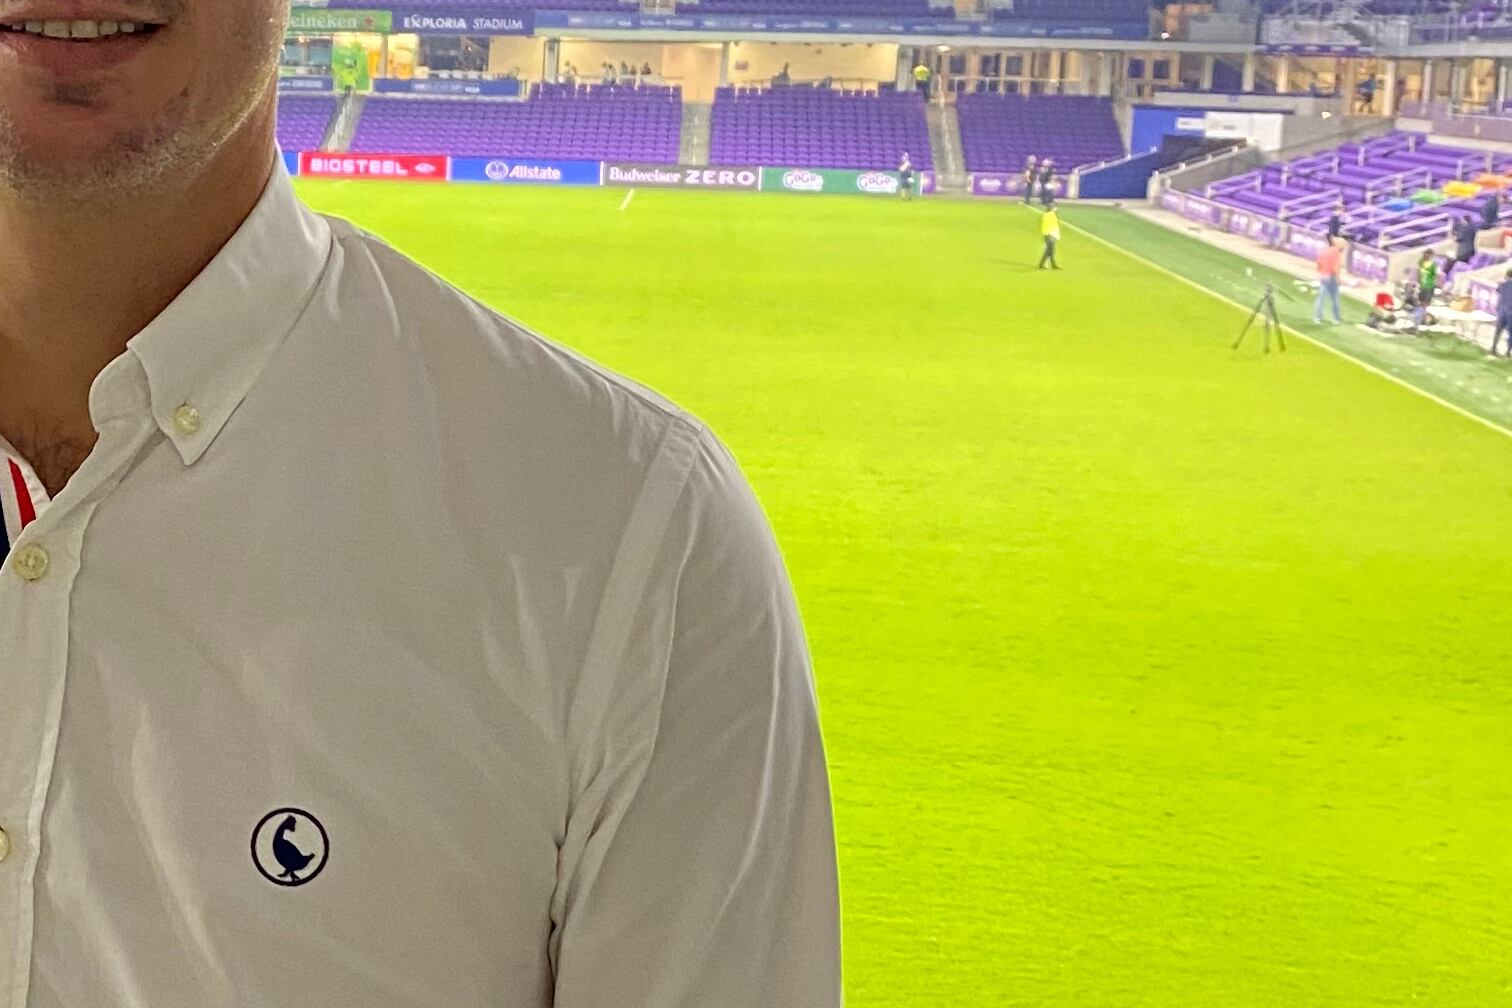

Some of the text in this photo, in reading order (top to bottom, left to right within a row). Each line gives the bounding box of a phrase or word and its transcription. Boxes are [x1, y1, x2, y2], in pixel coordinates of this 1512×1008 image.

[289, 13, 358, 28] eineken
[403, 14, 524, 31] EXPLORIA STADIUM
[310, 157, 409, 175] BIOSTEEL
[508, 165, 561, 180] Allstate
[609, 166, 756, 185] Budweiser ZERO
